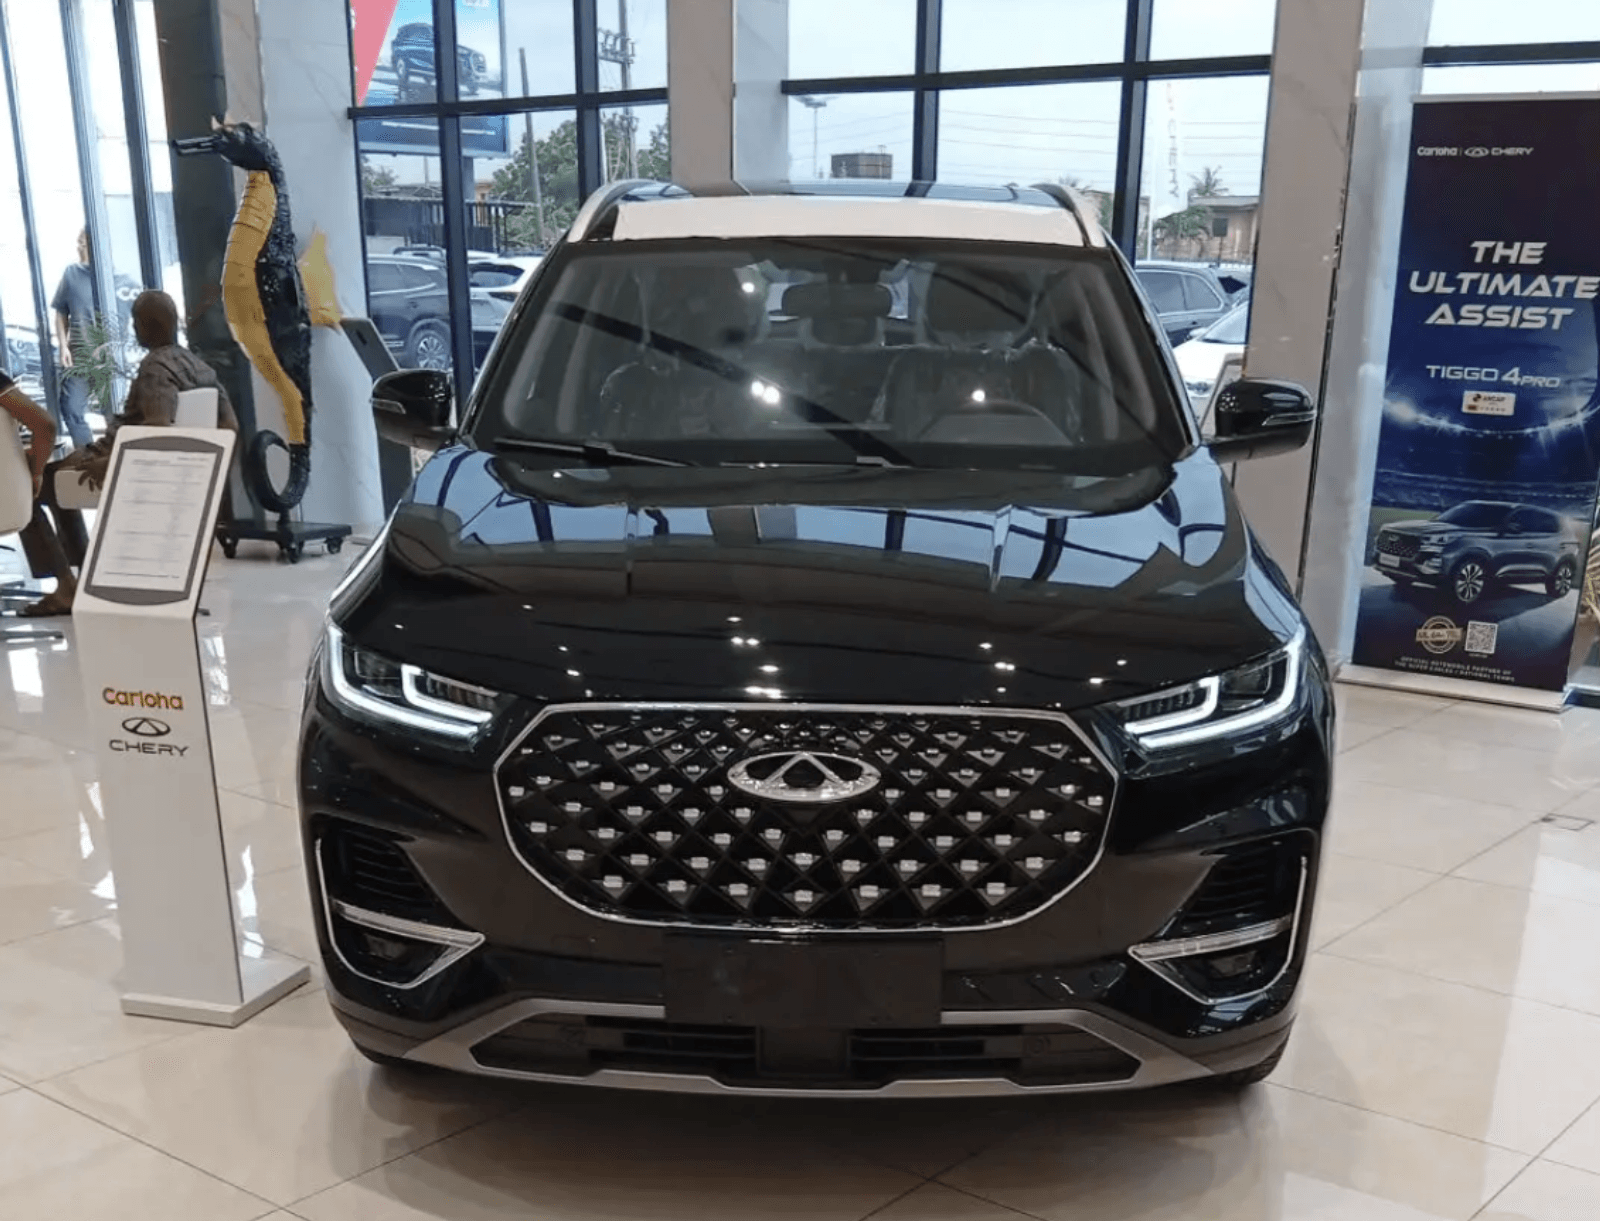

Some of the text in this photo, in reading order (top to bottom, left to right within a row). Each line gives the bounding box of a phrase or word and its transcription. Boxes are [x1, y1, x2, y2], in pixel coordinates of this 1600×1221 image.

[1417, 146, 1534, 156] Carloha CHERY
[1470, 241, 1547, 264] THE
[1409, 271, 1600, 298] ULTIMATE
[1424, 303, 1575, 330] ASSIST
[1426, 365, 1499, 381] TIGGO
[102, 687, 184, 711] Carloha
[109, 739, 189, 756] CHERY
